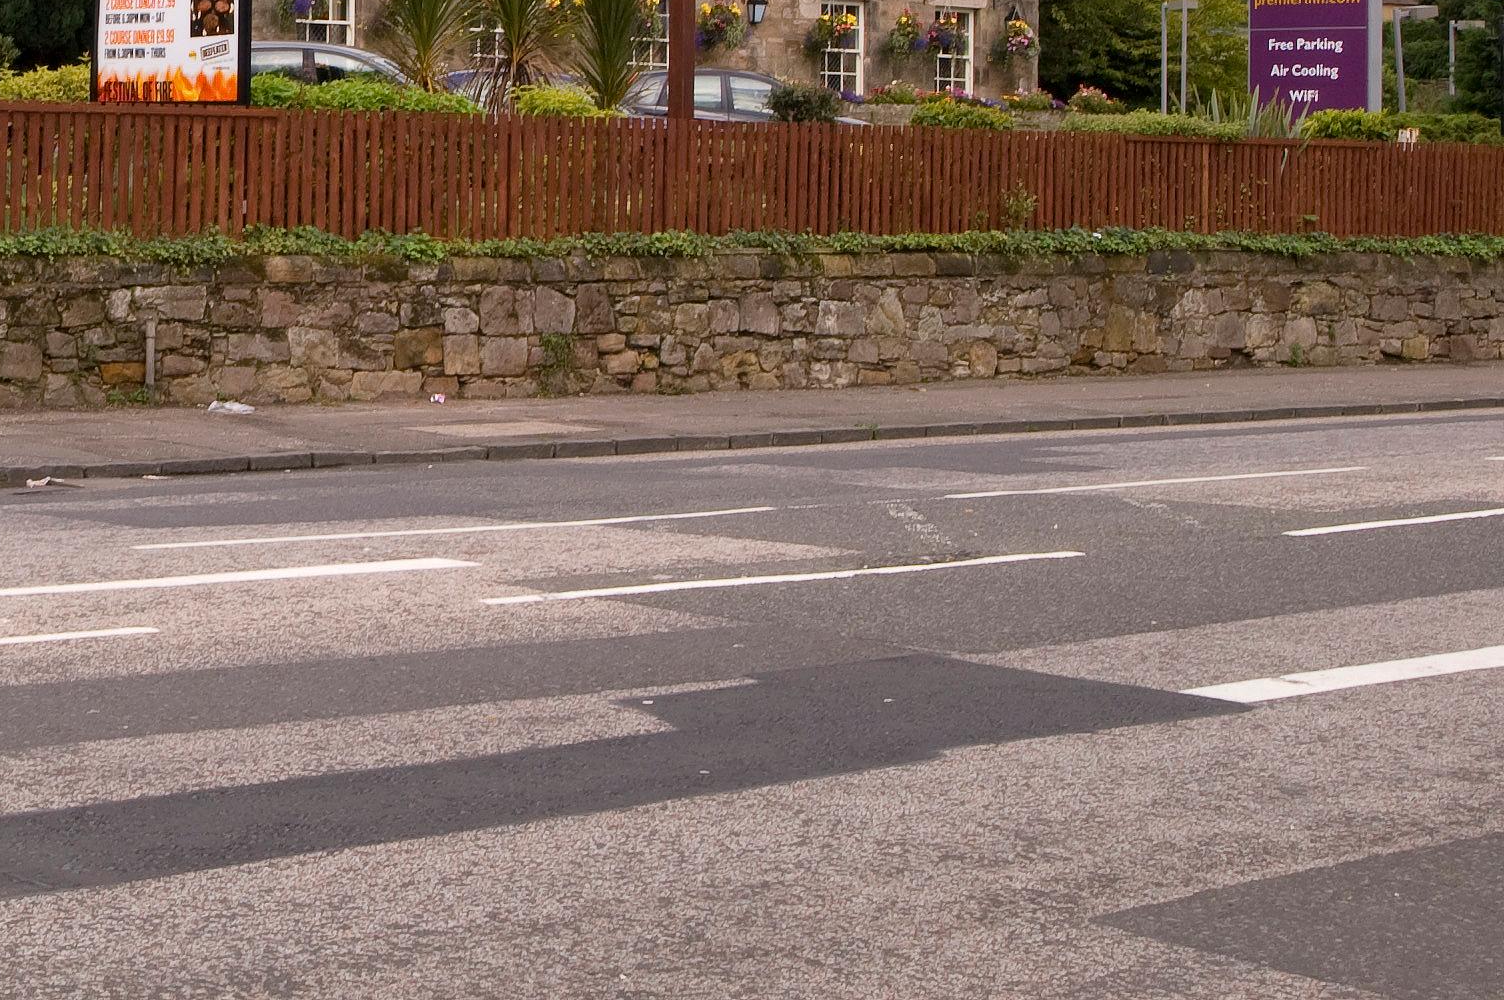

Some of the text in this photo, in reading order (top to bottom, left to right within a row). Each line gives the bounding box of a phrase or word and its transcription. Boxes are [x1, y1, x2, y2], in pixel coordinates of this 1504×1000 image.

[1268, 37, 1344, 54] Free Parking
[1270, 63, 1339, 80] Air Cooling
